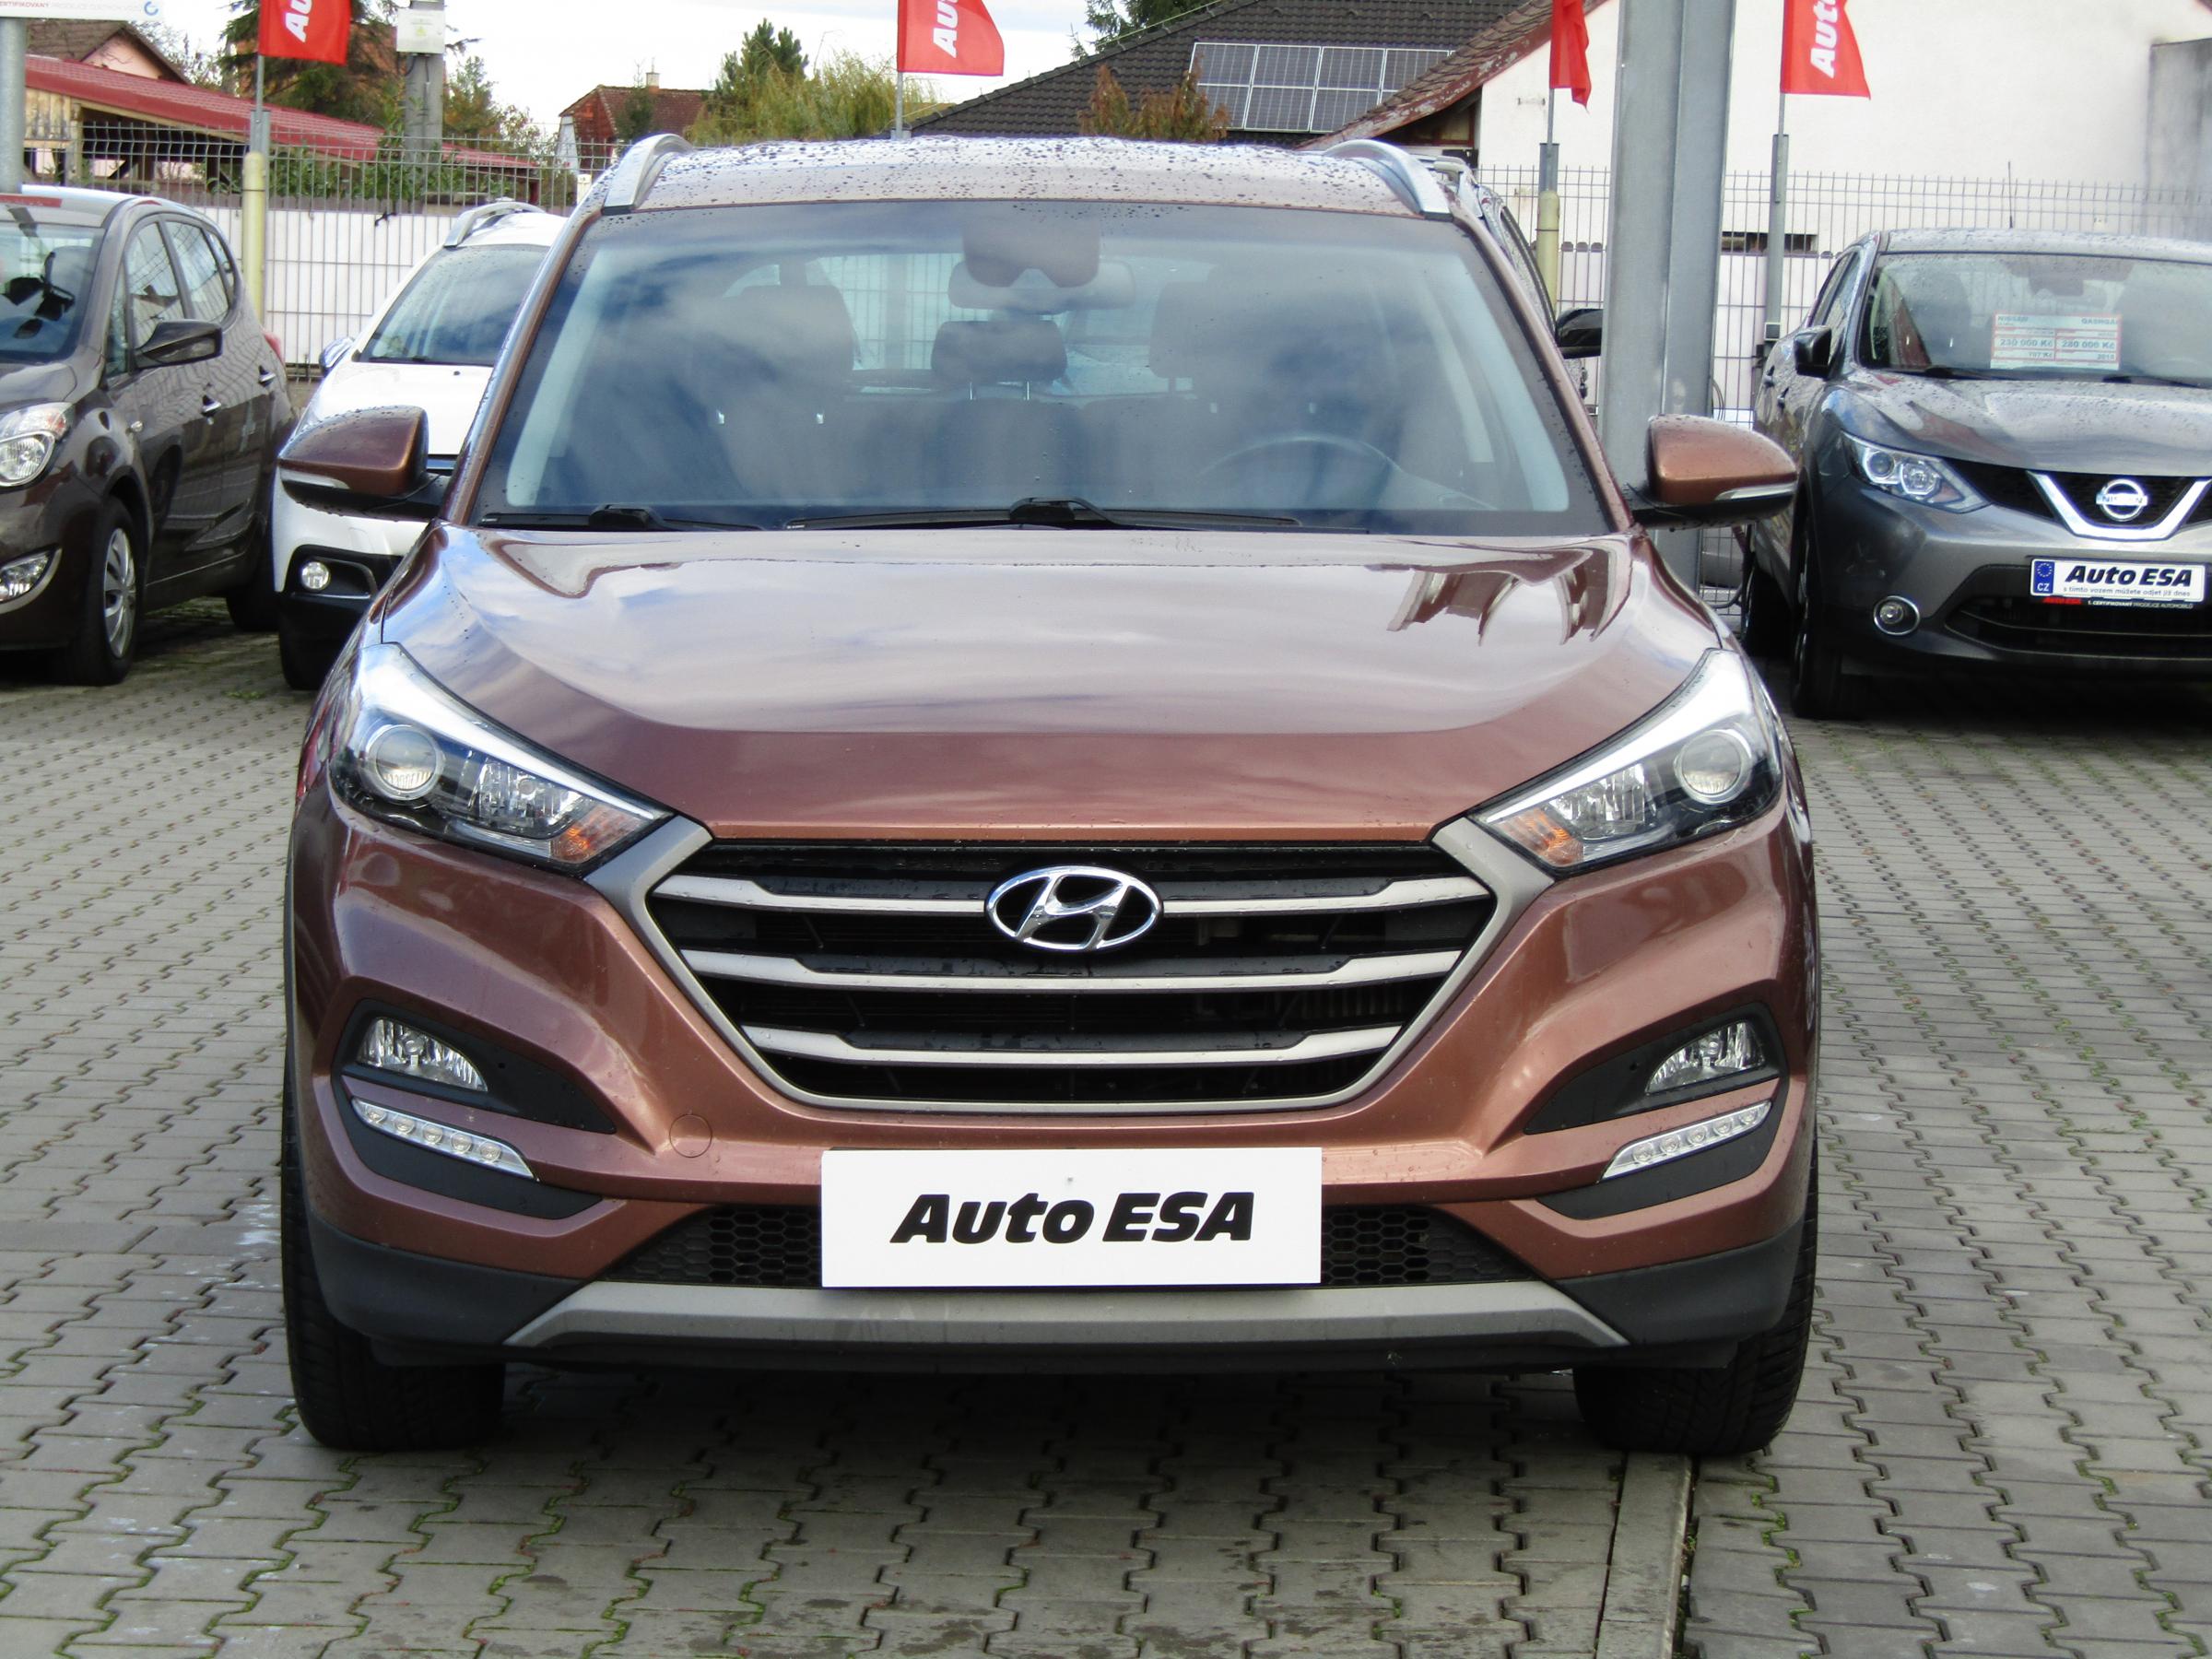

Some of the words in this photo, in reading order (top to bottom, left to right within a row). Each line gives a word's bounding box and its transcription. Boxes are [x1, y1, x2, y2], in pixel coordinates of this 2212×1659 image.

[933, 0, 959, 58] Au
[1810, 0, 1838, 78] Aut
[2037, 582, 2050, 592] CZ
[2065, 565, 2136, 584] Auto
[2138, 568, 2192, 587] ESA
[889, 1193, 1095, 1244] Auto
[1102, 1191, 1255, 1242] ESA
